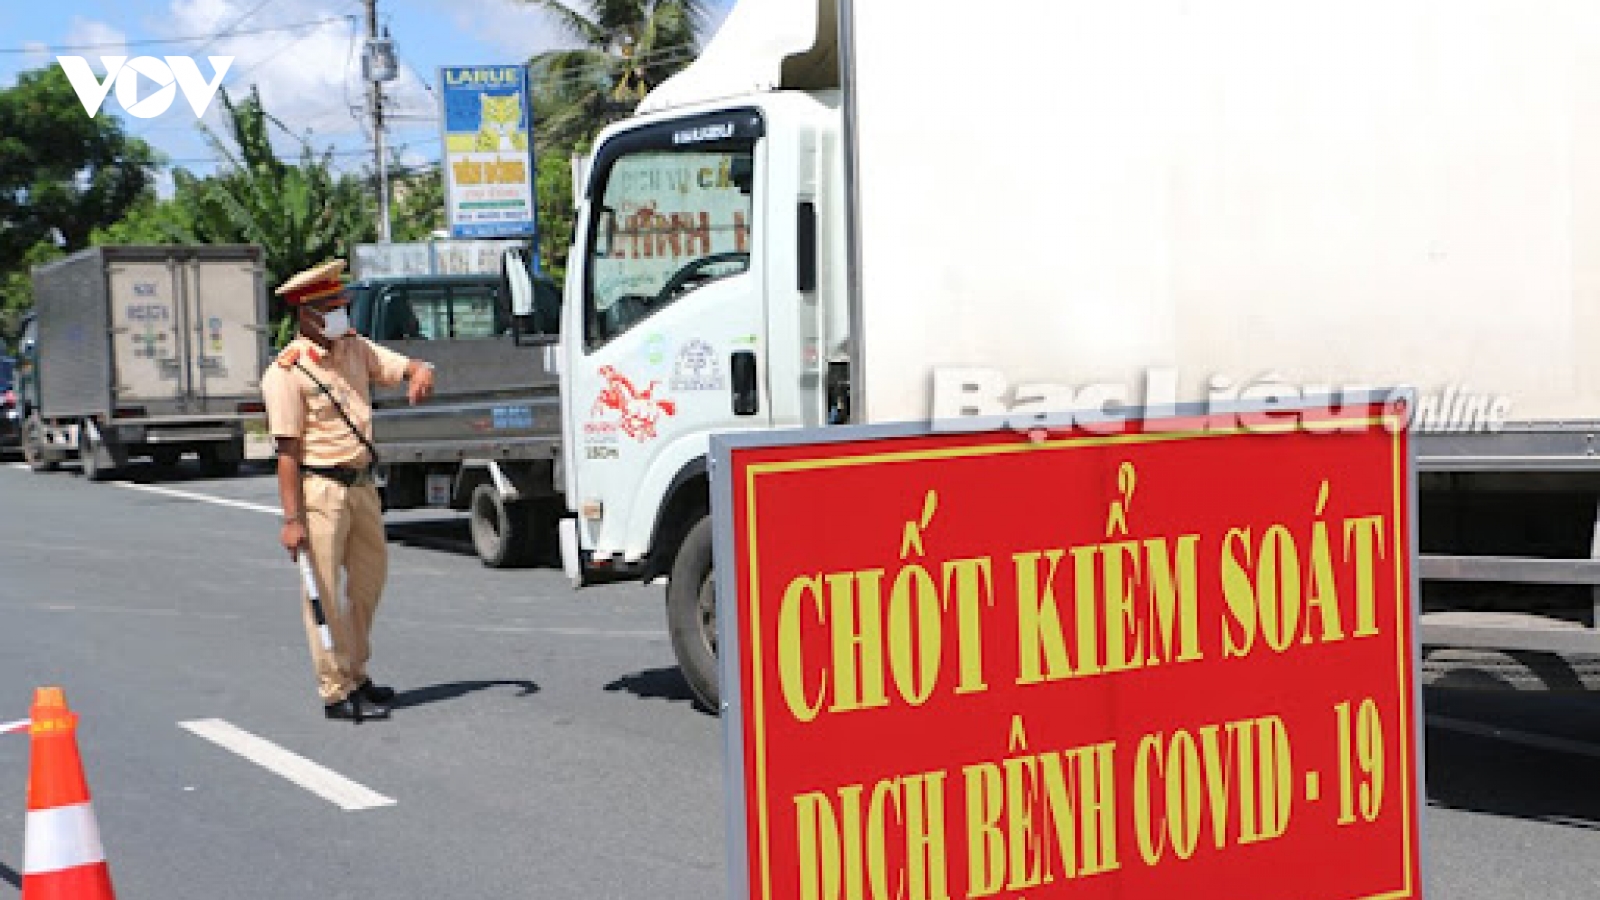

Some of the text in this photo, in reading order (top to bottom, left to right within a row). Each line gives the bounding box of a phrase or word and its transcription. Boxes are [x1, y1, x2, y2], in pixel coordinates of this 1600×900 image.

[446, 67, 519, 84] LARUE
[673, 122, 735, 144] ISUZU
[777, 461, 1385, 722] CHỐT KIỂM SOÁT
[1133, 715, 1292, 866] COVID
[1334, 697, 1385, 826] 19
